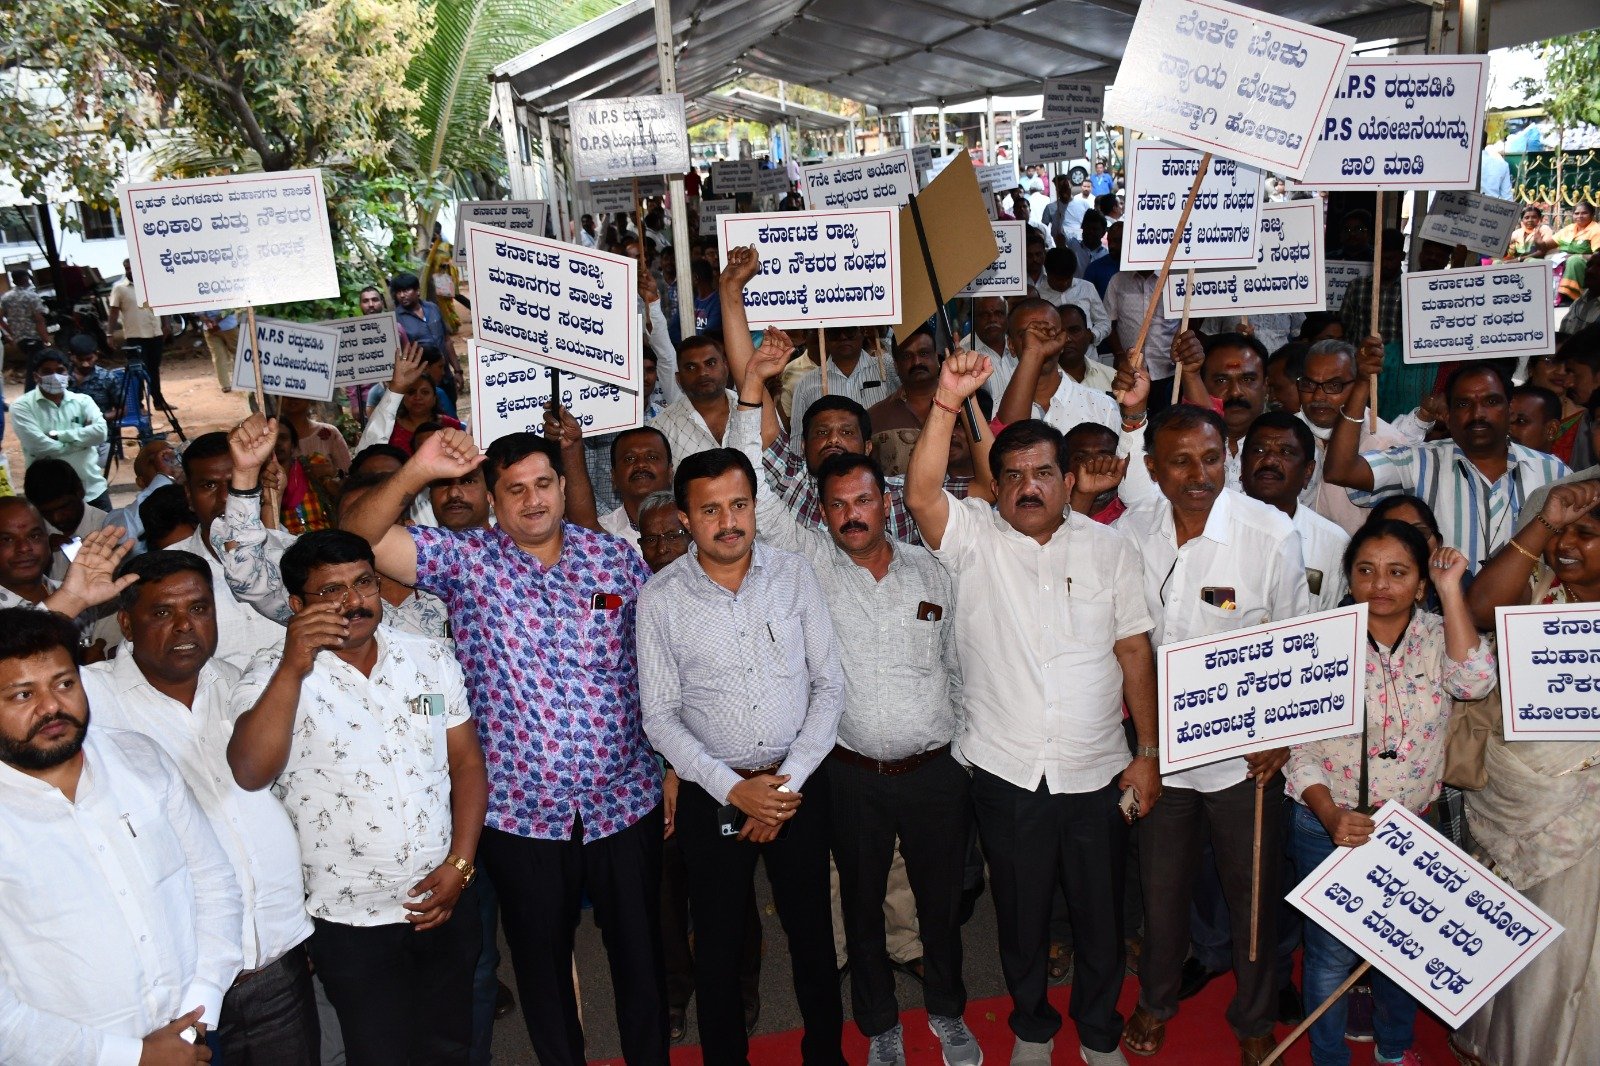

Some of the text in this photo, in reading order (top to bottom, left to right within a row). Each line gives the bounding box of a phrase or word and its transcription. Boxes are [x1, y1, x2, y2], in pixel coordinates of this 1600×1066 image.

[1176, 10, 1307, 68] ಬೇಕೇ ಬೇಕು
[1160, 51, 1297, 110] ನ್ಯಾಯ ಬೇಕು
[1384, 73, 1455, 109] ರದ್ದುಪಡಿಸಿ
[588, 109, 619, 126] N.P.S
[1225, 111, 1302, 150] ಹೋರಾಟ
[580, 135, 609, 151] O.P.S
[1358, 115, 1469, 149] ಯೋಜನೆಯನ್ನು
[808, 170, 830, 188] 7ನೇ
[834, 168, 863, 184] ವೇತನ
[867, 159, 907, 178] ಆಯೋಗ
[1214, 158, 1238, 187] ರಾಜ್ಯ
[1341, 153, 1424, 176] ಜಾರಿ ಮಾಡಿ
[135, 195, 166, 214] ಬೃಹತ್
[171, 193, 224, 207] ಬೆಂಗಳೂರು
[228, 187, 278, 202] ಮಹಾನಗರ
[825, 183, 897, 209] ಮಧ್ಯಂತರ ವರದಿ
[1137, 188, 1176, 211] ಸರ್ಕಾರಿ
[1223, 187, 1255, 212] ಸಂಘದ
[143, 205, 312, 238] ಅಧಿಕಾರಿ ಮತ್ತು ನೌಕರರ
[758, 220, 859, 249] ಕರ್ನಾಟಕ ರಾಜ್ಯ
[1136, 221, 1250, 255] ಹೋರಾಕ್ಕೆ ಜಯವಾಗಲಿ
[1270, 240, 1310, 264] ಸಂಘದ
[495, 240, 605, 290] ಕರ್ನಾಟಕ ರಾಜ್ಯ
[789, 251, 837, 275] ನೌಕರರ
[844, 249, 887, 274] ಸಂಘದ
[488, 266, 613, 310] ಮಹಾನಗರ ಪಾಲಿಕೆ
[814, 281, 886, 304] ಜಯವಾಗಲಿ
[975, 275, 1020, 287] ಜಯವಾಗಲಿ
[1243, 271, 1309, 293] ಜಯವಾಗಲಿ
[1428, 272, 1525, 291] ಕರ್ನಾಟಕ ರಾಜ್ಯ
[1421, 289, 1532, 311] ಮಹಾನಗರ ಪಾಲಿಕೆ
[499, 293, 604, 336] ನೌಕರರ ಸಂಘದ
[1430, 311, 1525, 330] ನೌಕರರ ಸಂಘದ
[257, 327, 284, 344] N.P.S
[482, 315, 625, 366] ಹೋರಾಟಕ್ಕೆ ಜಯವಾಗಲಿ
[1413, 328, 1544, 350] ಹೋರಾಟಕ್ಕೆ ಜಯವಾಗಲಿ
[273, 354, 330, 380] ಯೋಜನೆಯನ್ನು
[358, 349, 385, 360] ಸಂಘದ
[285, 378, 307, 390] ಮಾಡಿ
[485, 366, 537, 388] ಅಧಿಕಾರಿ
[1204, 631, 1319, 670] ಕರ್ನಾಟಕ ರಾಜ್ಯ
[1173, 652, 1349, 711] ಸರ್ಕಾರಿ ನೌಕರರ ಸಂಘದ
[1176, 691, 1345, 744] ಹೋರಾಟಕ್ಕೆ ಜಯವಾಗಲಿ
[1376, 820, 1539, 946] 7ನೇ ವೇತನ ಆಯೋಗ
[1366, 864, 1483, 956] ಮಧ್ಯಂತರ ವರದಿ
[1324, 882, 1474, 994] ಜಾರಿ ಮಾಡಲು ಆಗ್ರಹ
